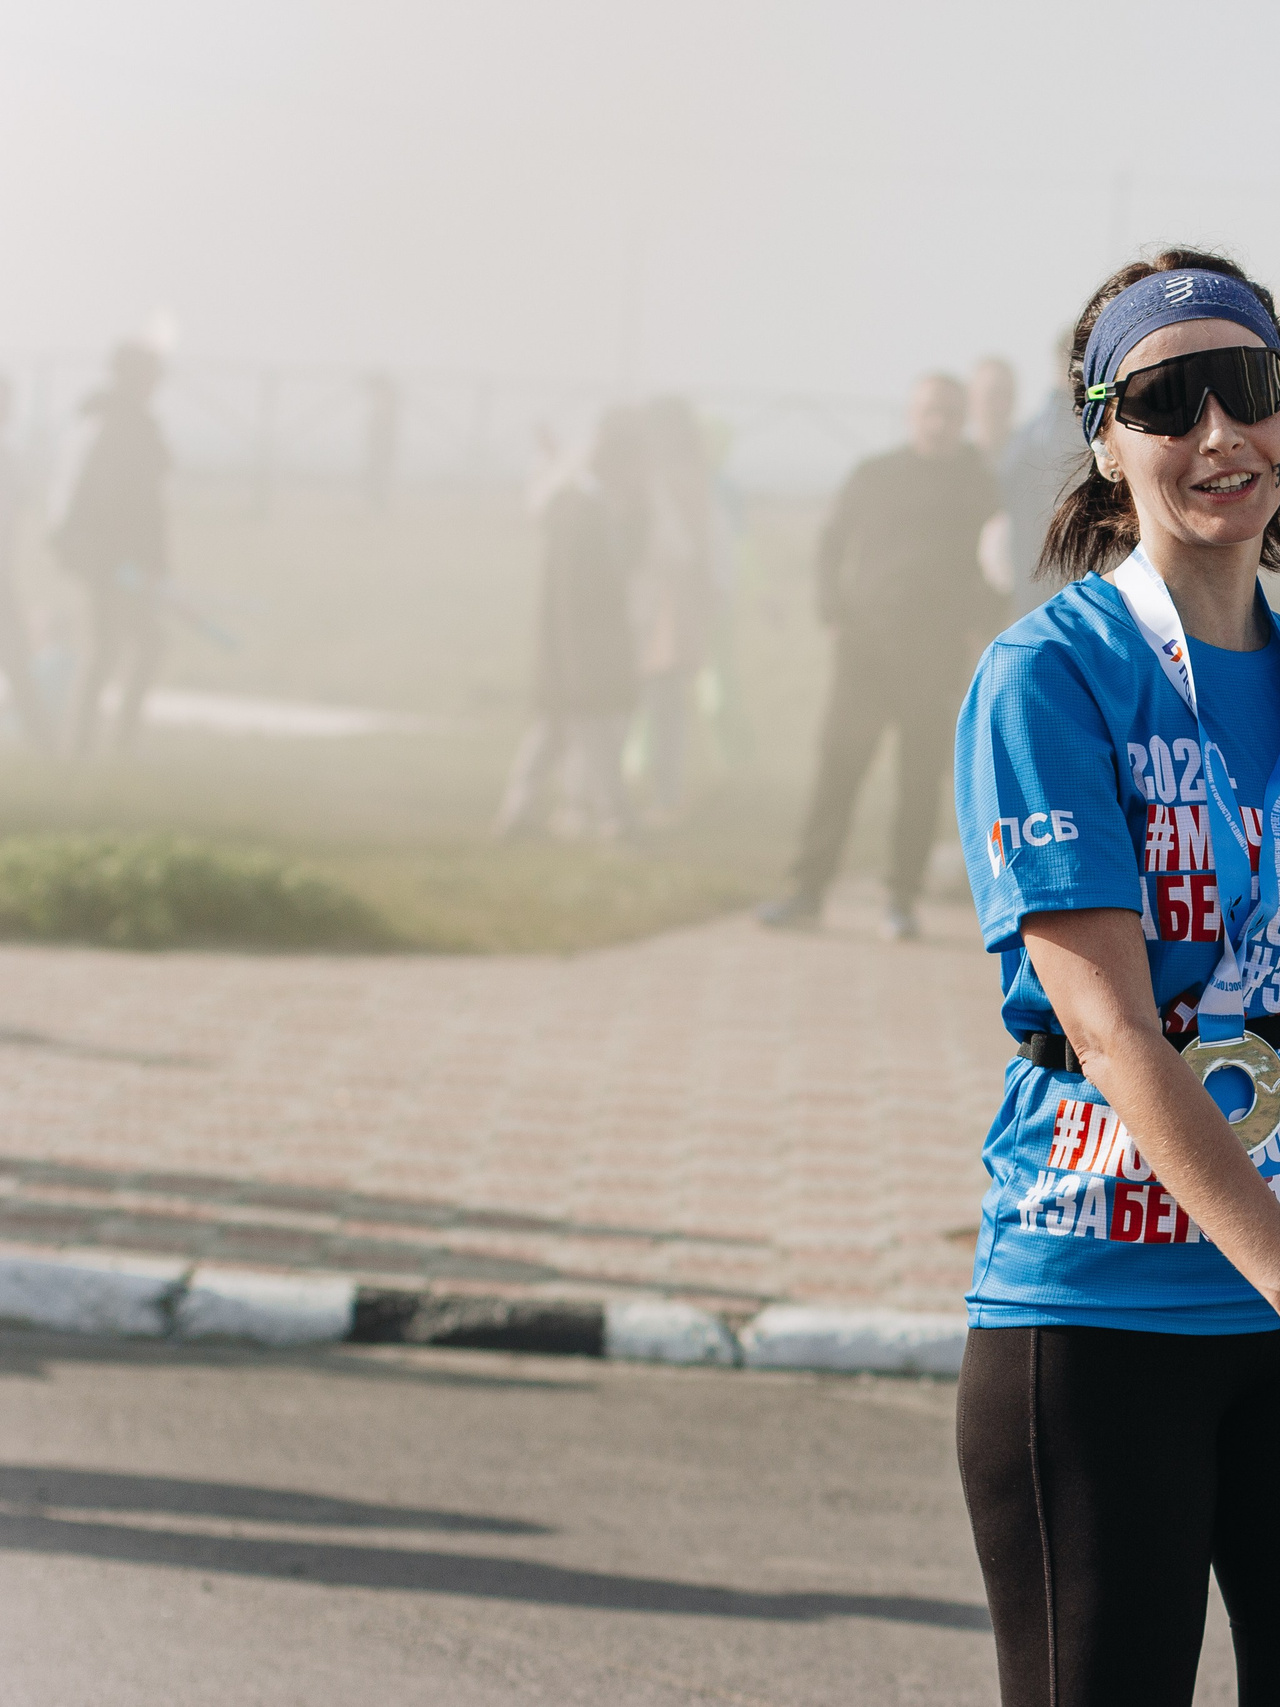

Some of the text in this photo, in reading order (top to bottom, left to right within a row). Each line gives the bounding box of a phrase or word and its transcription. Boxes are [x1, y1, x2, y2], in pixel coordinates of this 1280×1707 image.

[1127, 734, 1238, 804] 202
[999, 809, 1079, 849] ПСБ
[1047, 1099, 1161, 1183] #ЛЮ
